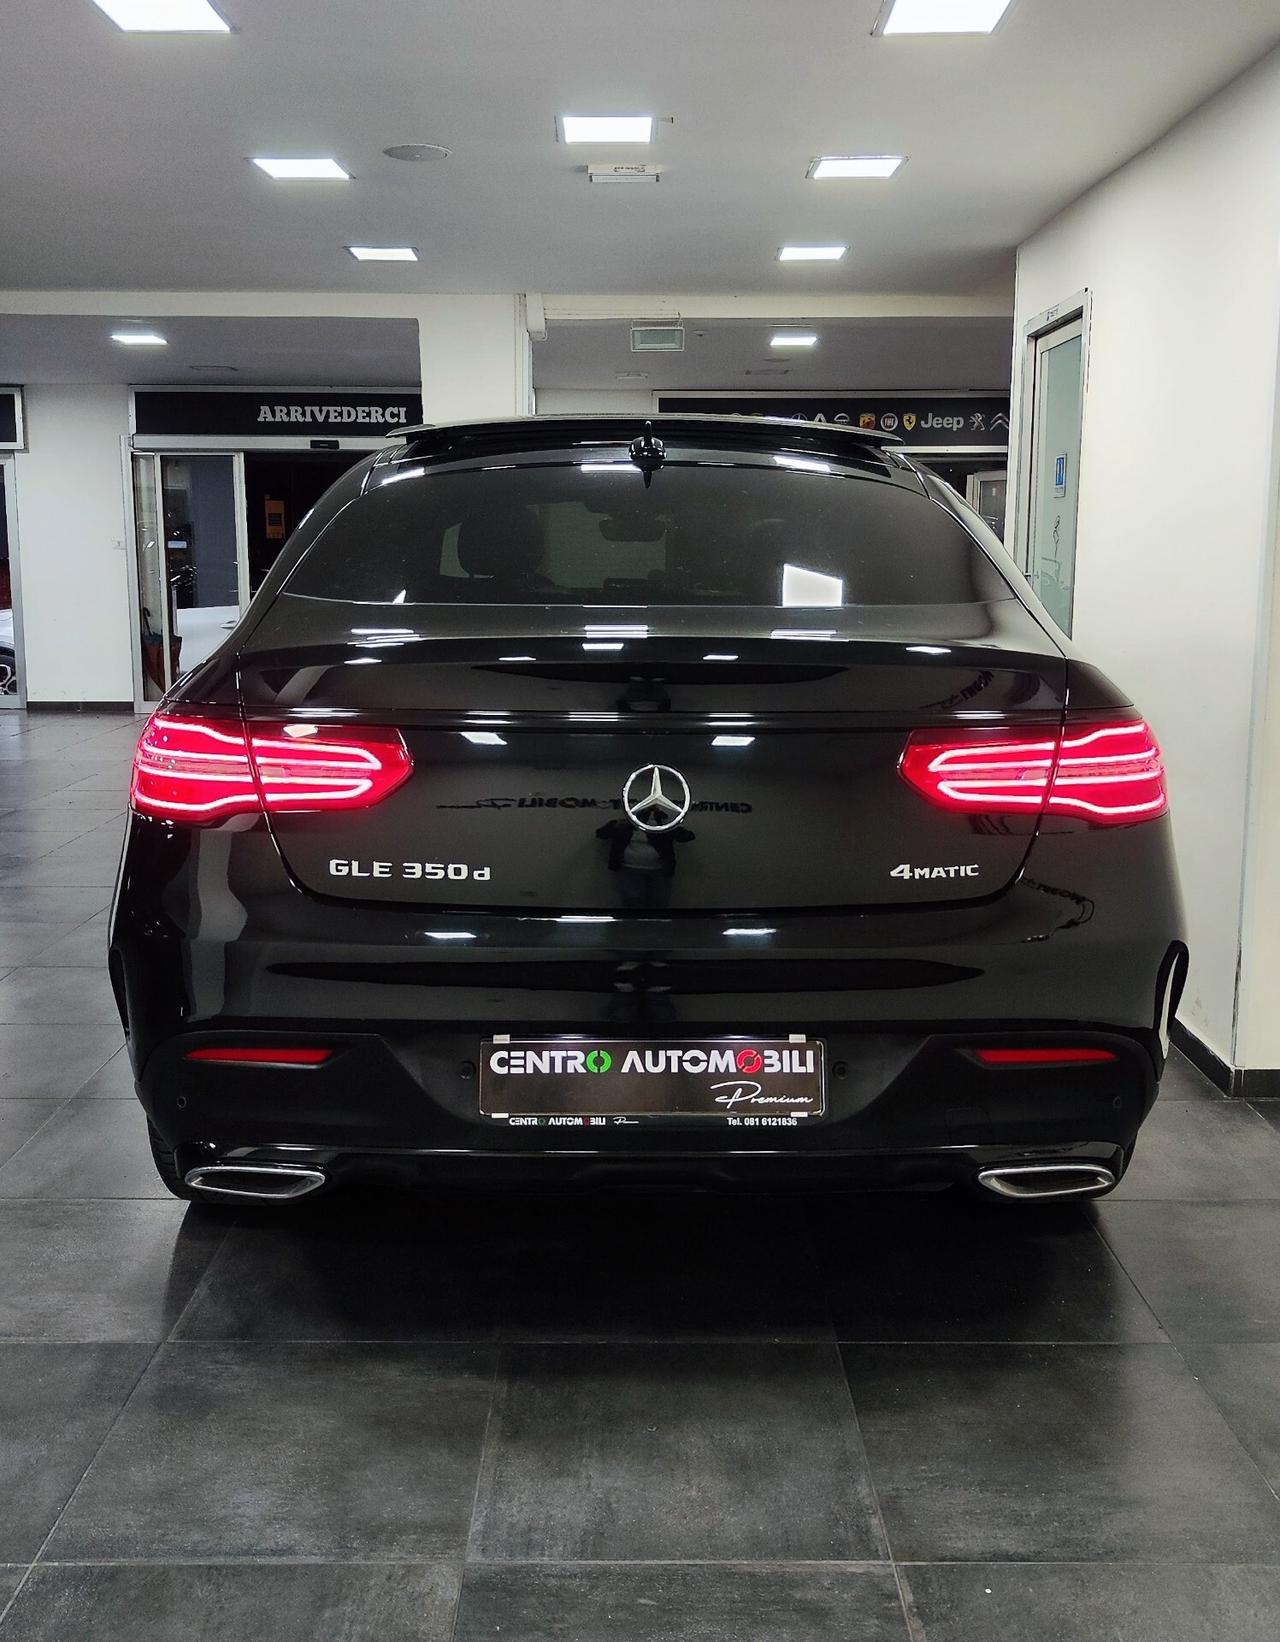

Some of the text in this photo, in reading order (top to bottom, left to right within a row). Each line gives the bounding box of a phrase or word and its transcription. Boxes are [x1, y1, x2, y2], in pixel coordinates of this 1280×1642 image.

[257, 405, 407, 424] ARRIVEDERCI
[921, 412, 964, 431] Jeep
[329, 858, 393, 878] GLE
[889, 863, 980, 880] 4MATIC
[489, 1048, 815, 1075] CENTRO AUTOMOBILI
[709, 1080, 814, 1109] Premium
[726, 1117, 743, 1126] Tel.
